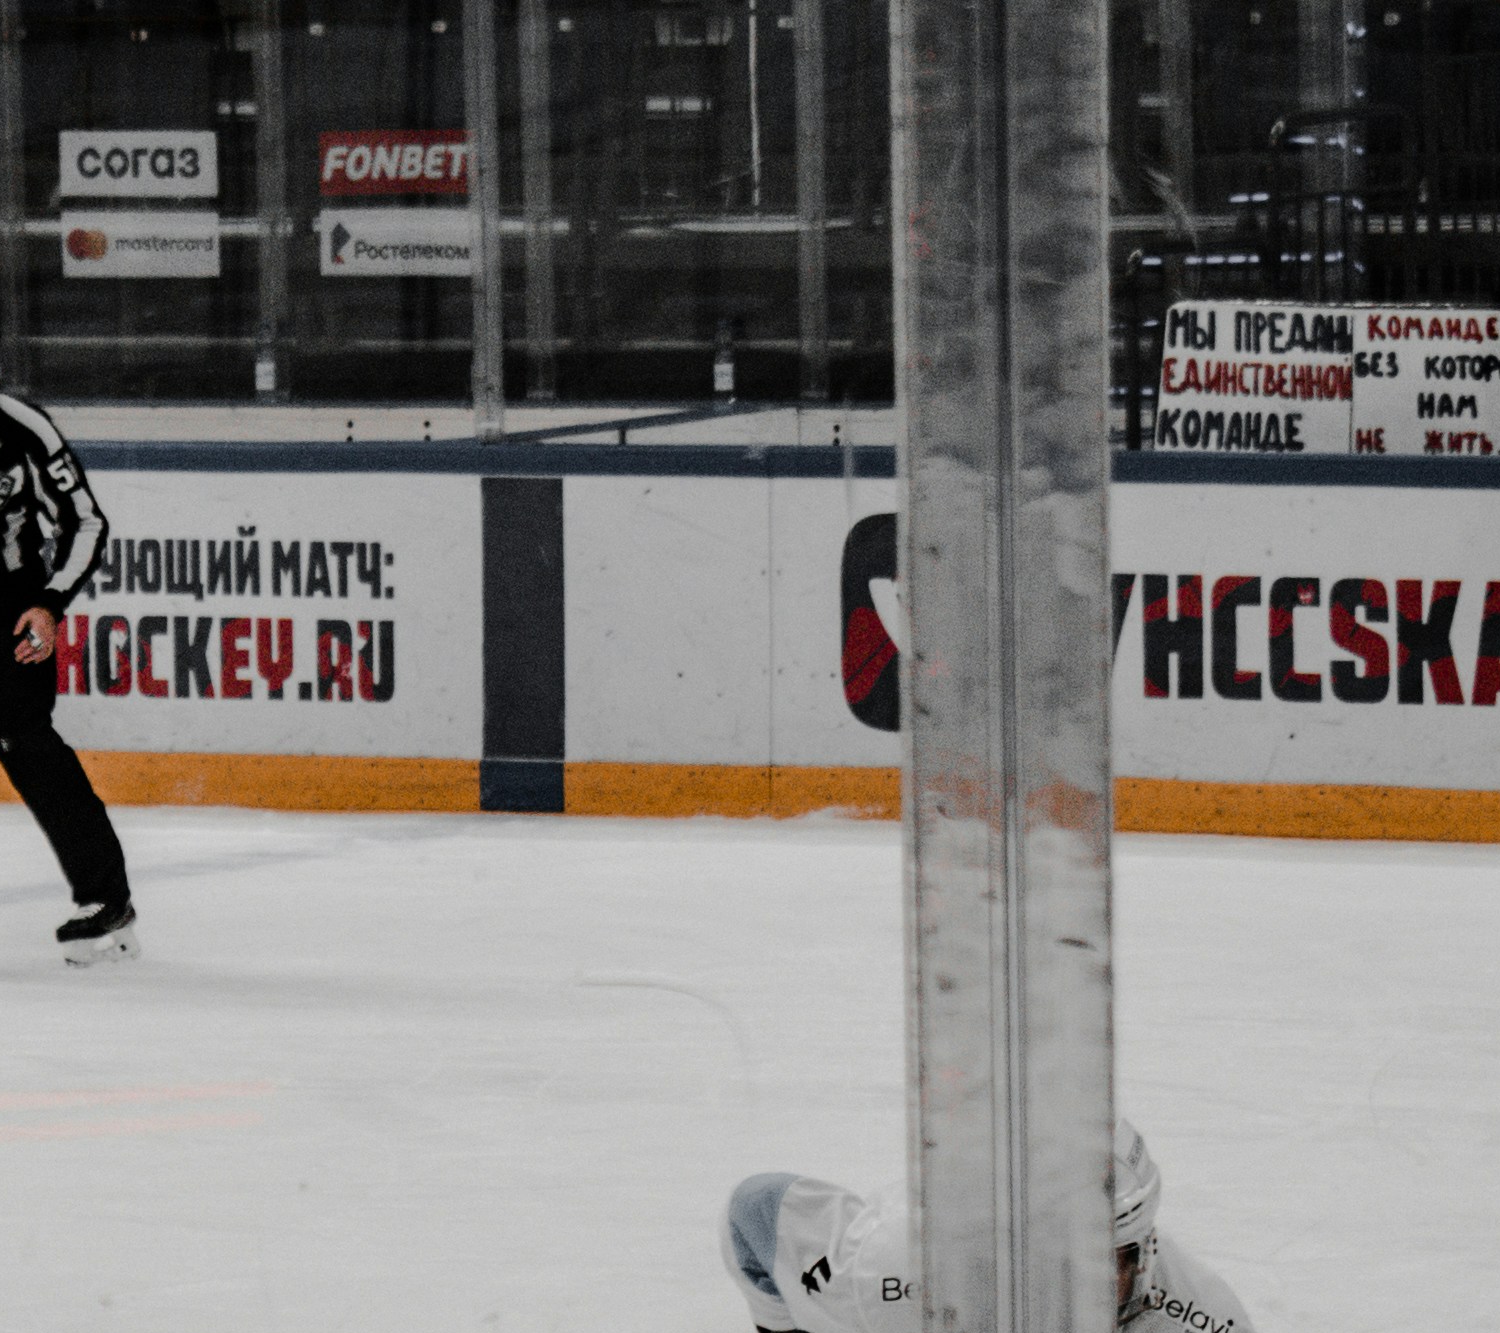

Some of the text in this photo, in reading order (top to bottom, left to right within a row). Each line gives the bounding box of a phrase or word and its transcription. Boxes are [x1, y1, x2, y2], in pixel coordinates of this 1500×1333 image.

[322, 143, 469, 182] FONBET
[1168, 310, 1216, 351] МЫ
[1354, 351, 1399, 378] БЕЗ
[1417, 392, 1479, 420] НАМ
[1156, 408, 1304, 452] КОМАНДЕ
[1355, 428, 1386, 454] НЕ
[272, 540, 394, 600] МАТЧ:
